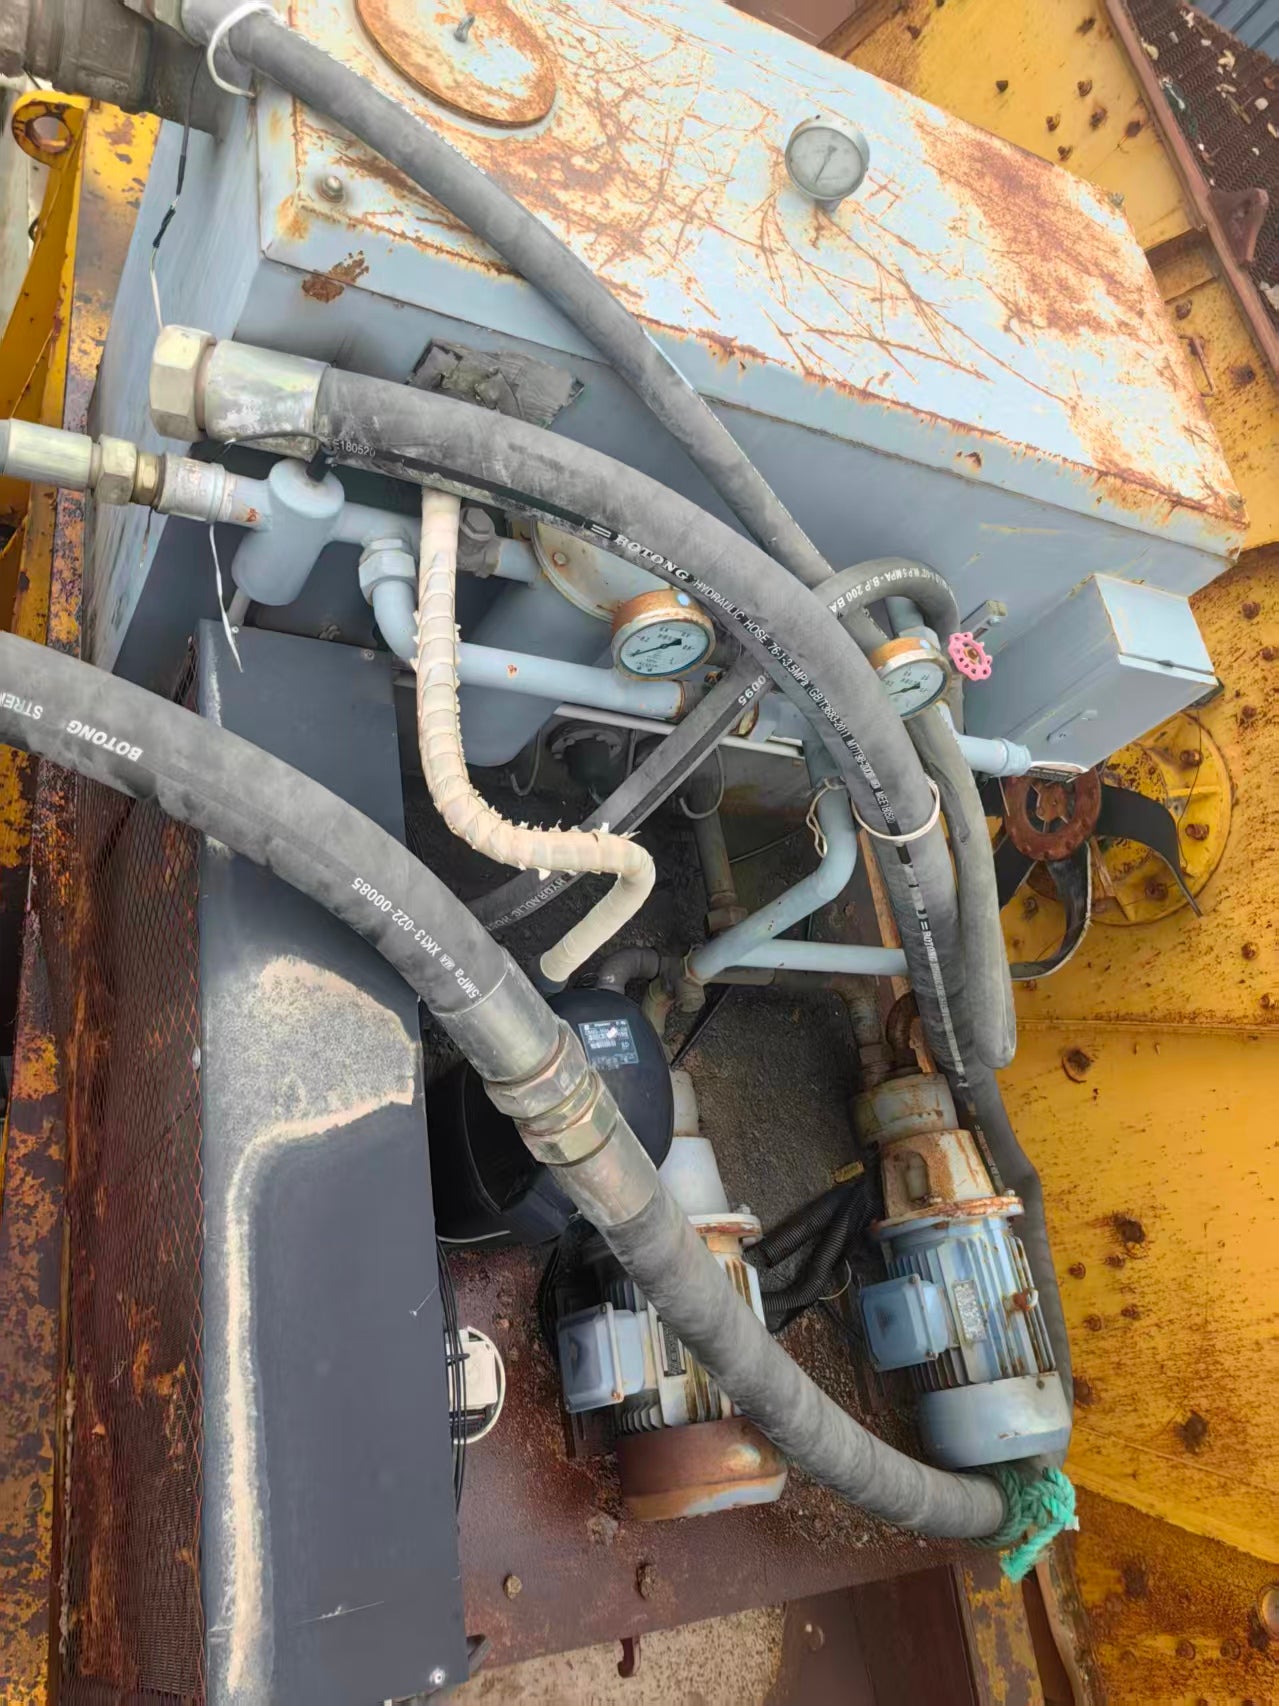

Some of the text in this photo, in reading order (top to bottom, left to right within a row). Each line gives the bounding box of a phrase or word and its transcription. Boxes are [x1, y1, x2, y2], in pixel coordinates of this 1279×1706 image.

[693, 579, 745, 620] HYDRAULIC
[743, 619, 770, 643] HOSE
[845, 584, 864, 602] 200
[66, 719, 144, 762] BOTONG
[351, 876, 442, 957] XK13-022-00085
[510, 878, 567, 918] HYDRAULIC
[455, 967, 483, 1000] .5MPa
